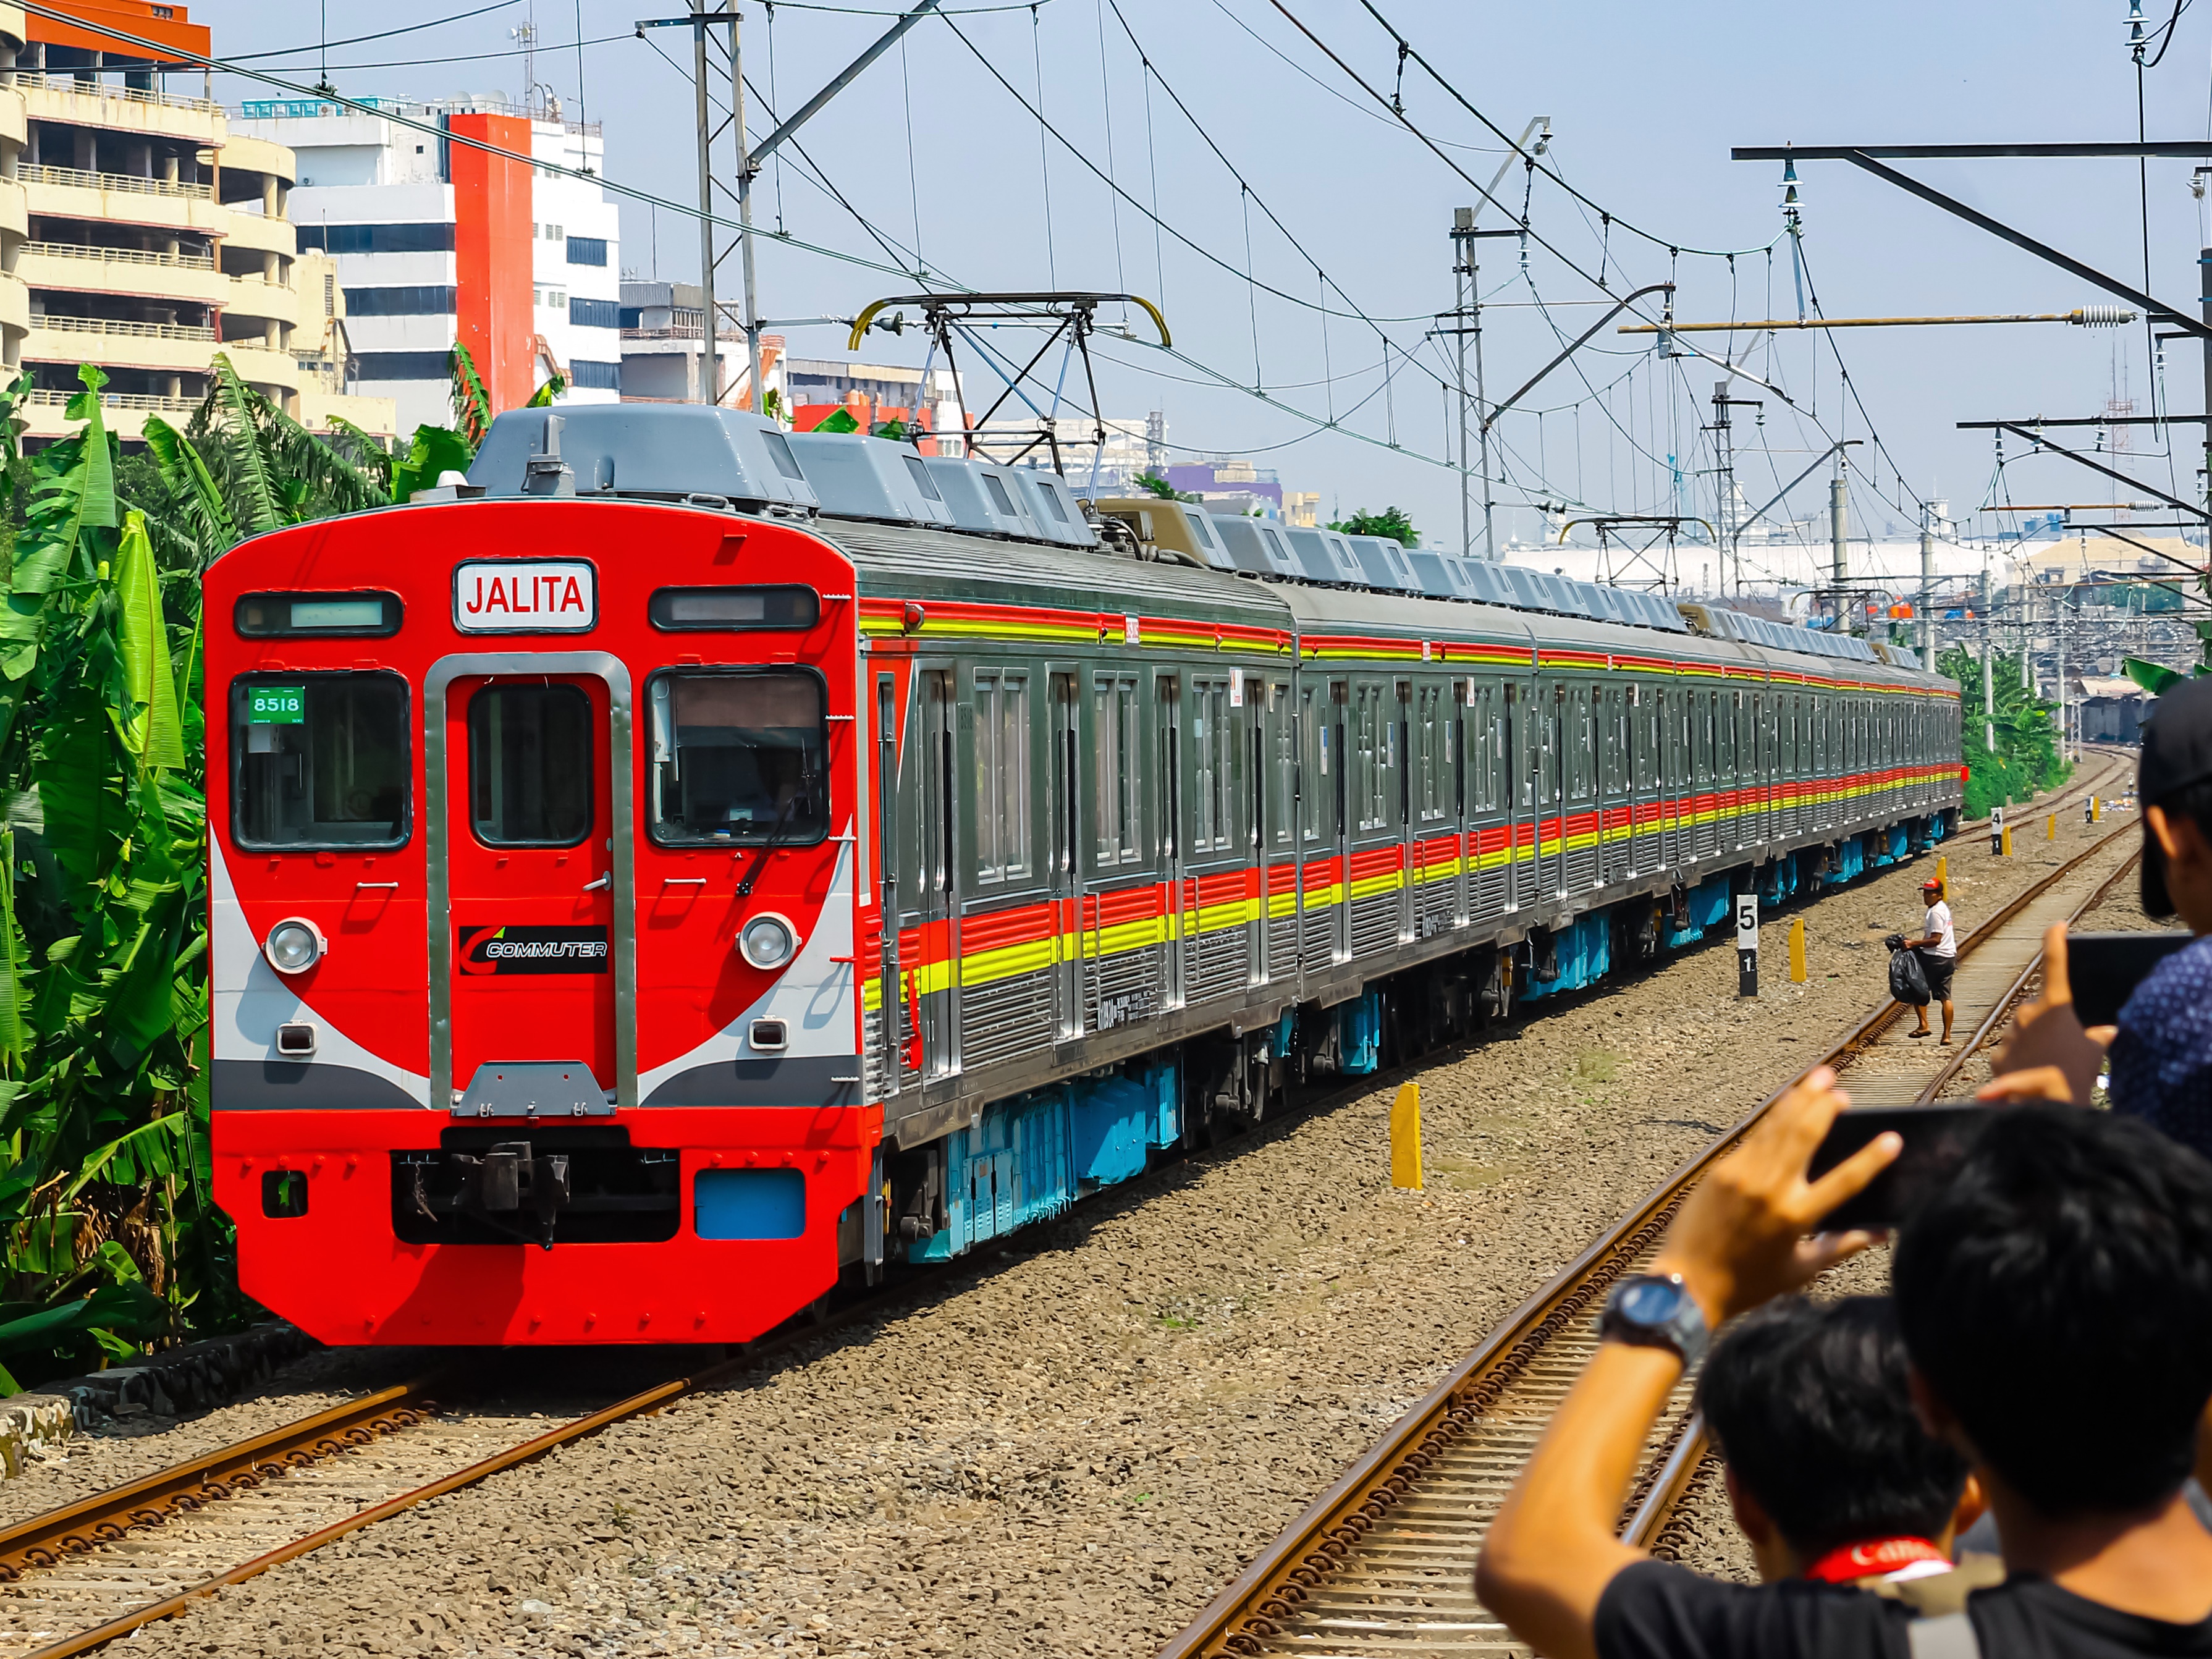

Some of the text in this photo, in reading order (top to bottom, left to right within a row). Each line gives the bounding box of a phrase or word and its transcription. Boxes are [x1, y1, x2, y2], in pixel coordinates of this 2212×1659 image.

[466, 576, 585, 614] JALITA
[254, 698, 299, 712] 8518
[1993, 813, 2001, 824] 4
[1995, 840, 1999, 848] 1
[1740, 905, 1755, 931] 5
[486, 942, 608, 958] COMMUTER
[1744, 956, 1751, 972] 1
